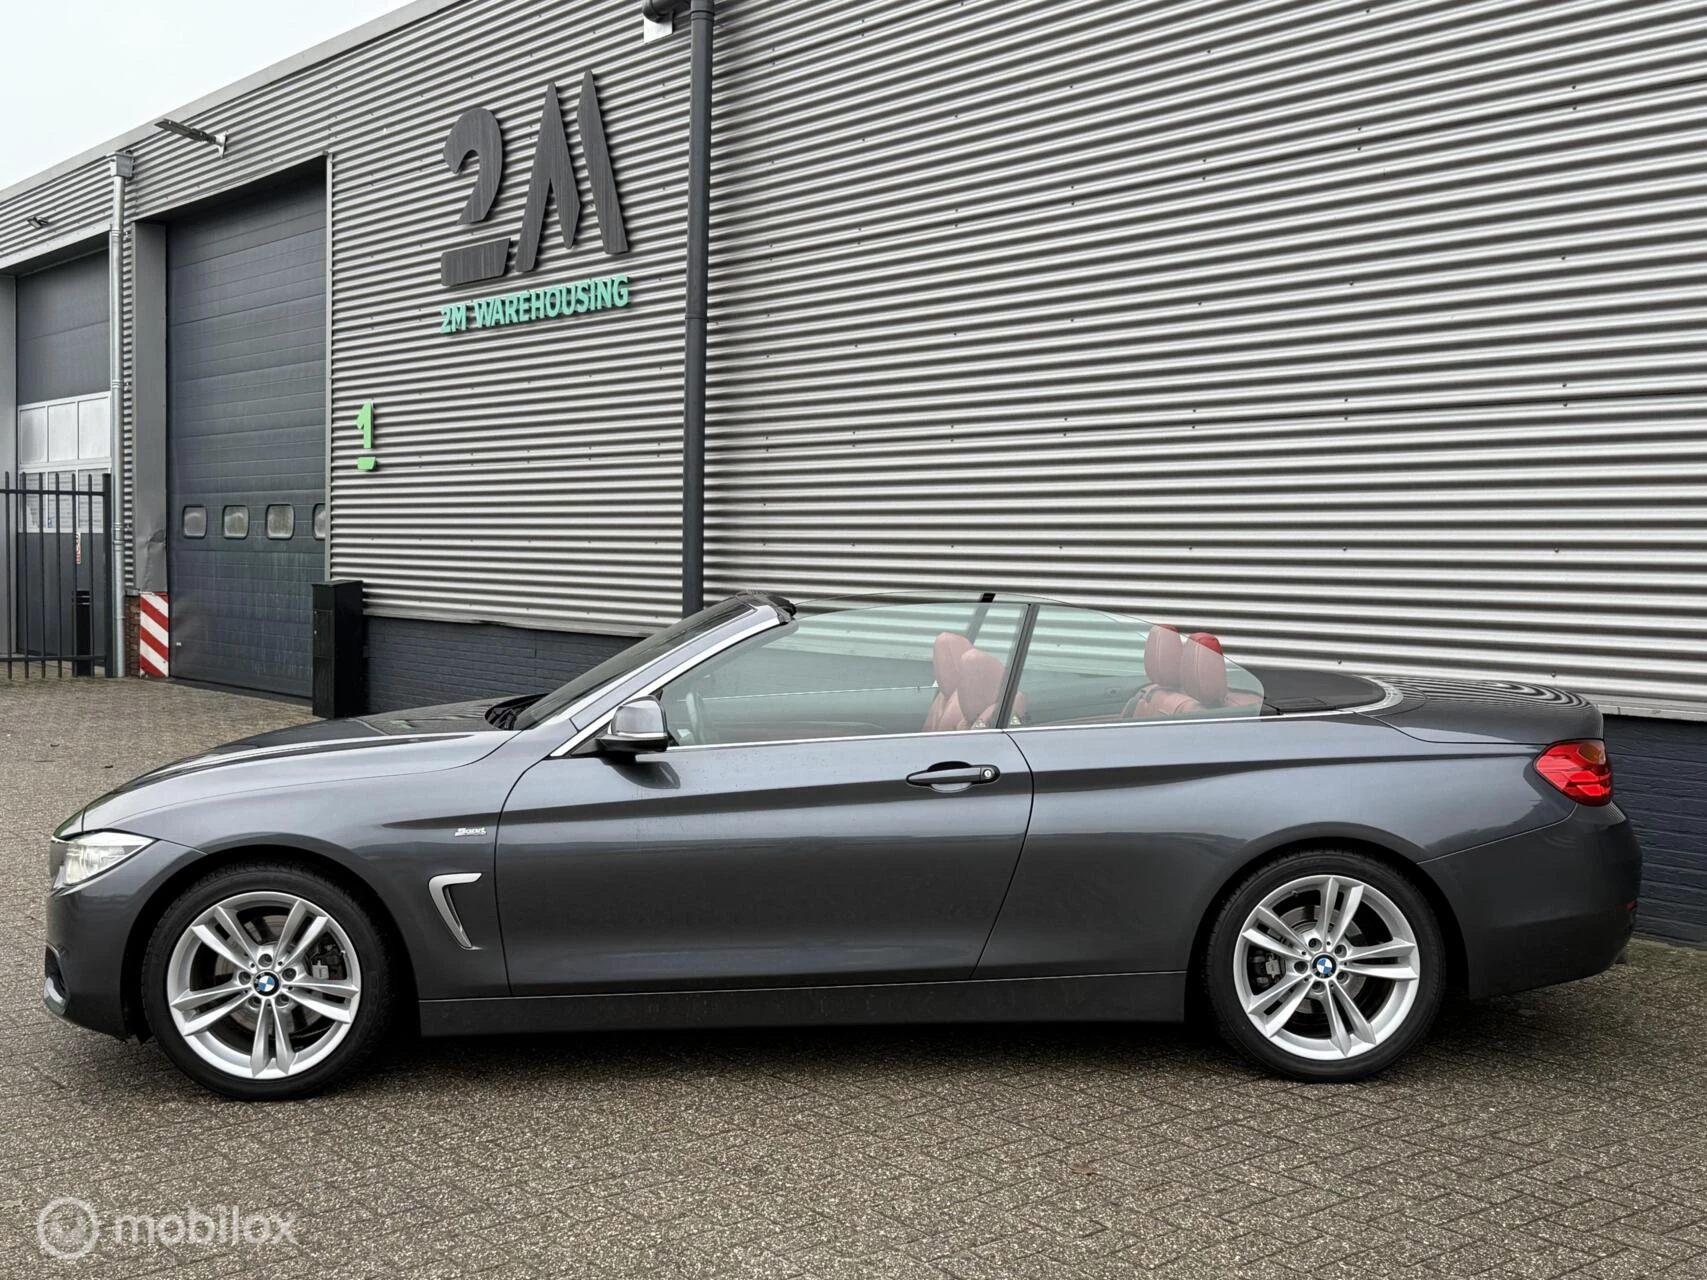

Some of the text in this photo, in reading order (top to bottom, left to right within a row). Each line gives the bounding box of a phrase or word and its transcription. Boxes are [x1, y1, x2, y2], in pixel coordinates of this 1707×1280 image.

[440, 70, 629, 287] 2M
[439, 273, 630, 334] 2M WAREHOUSING
